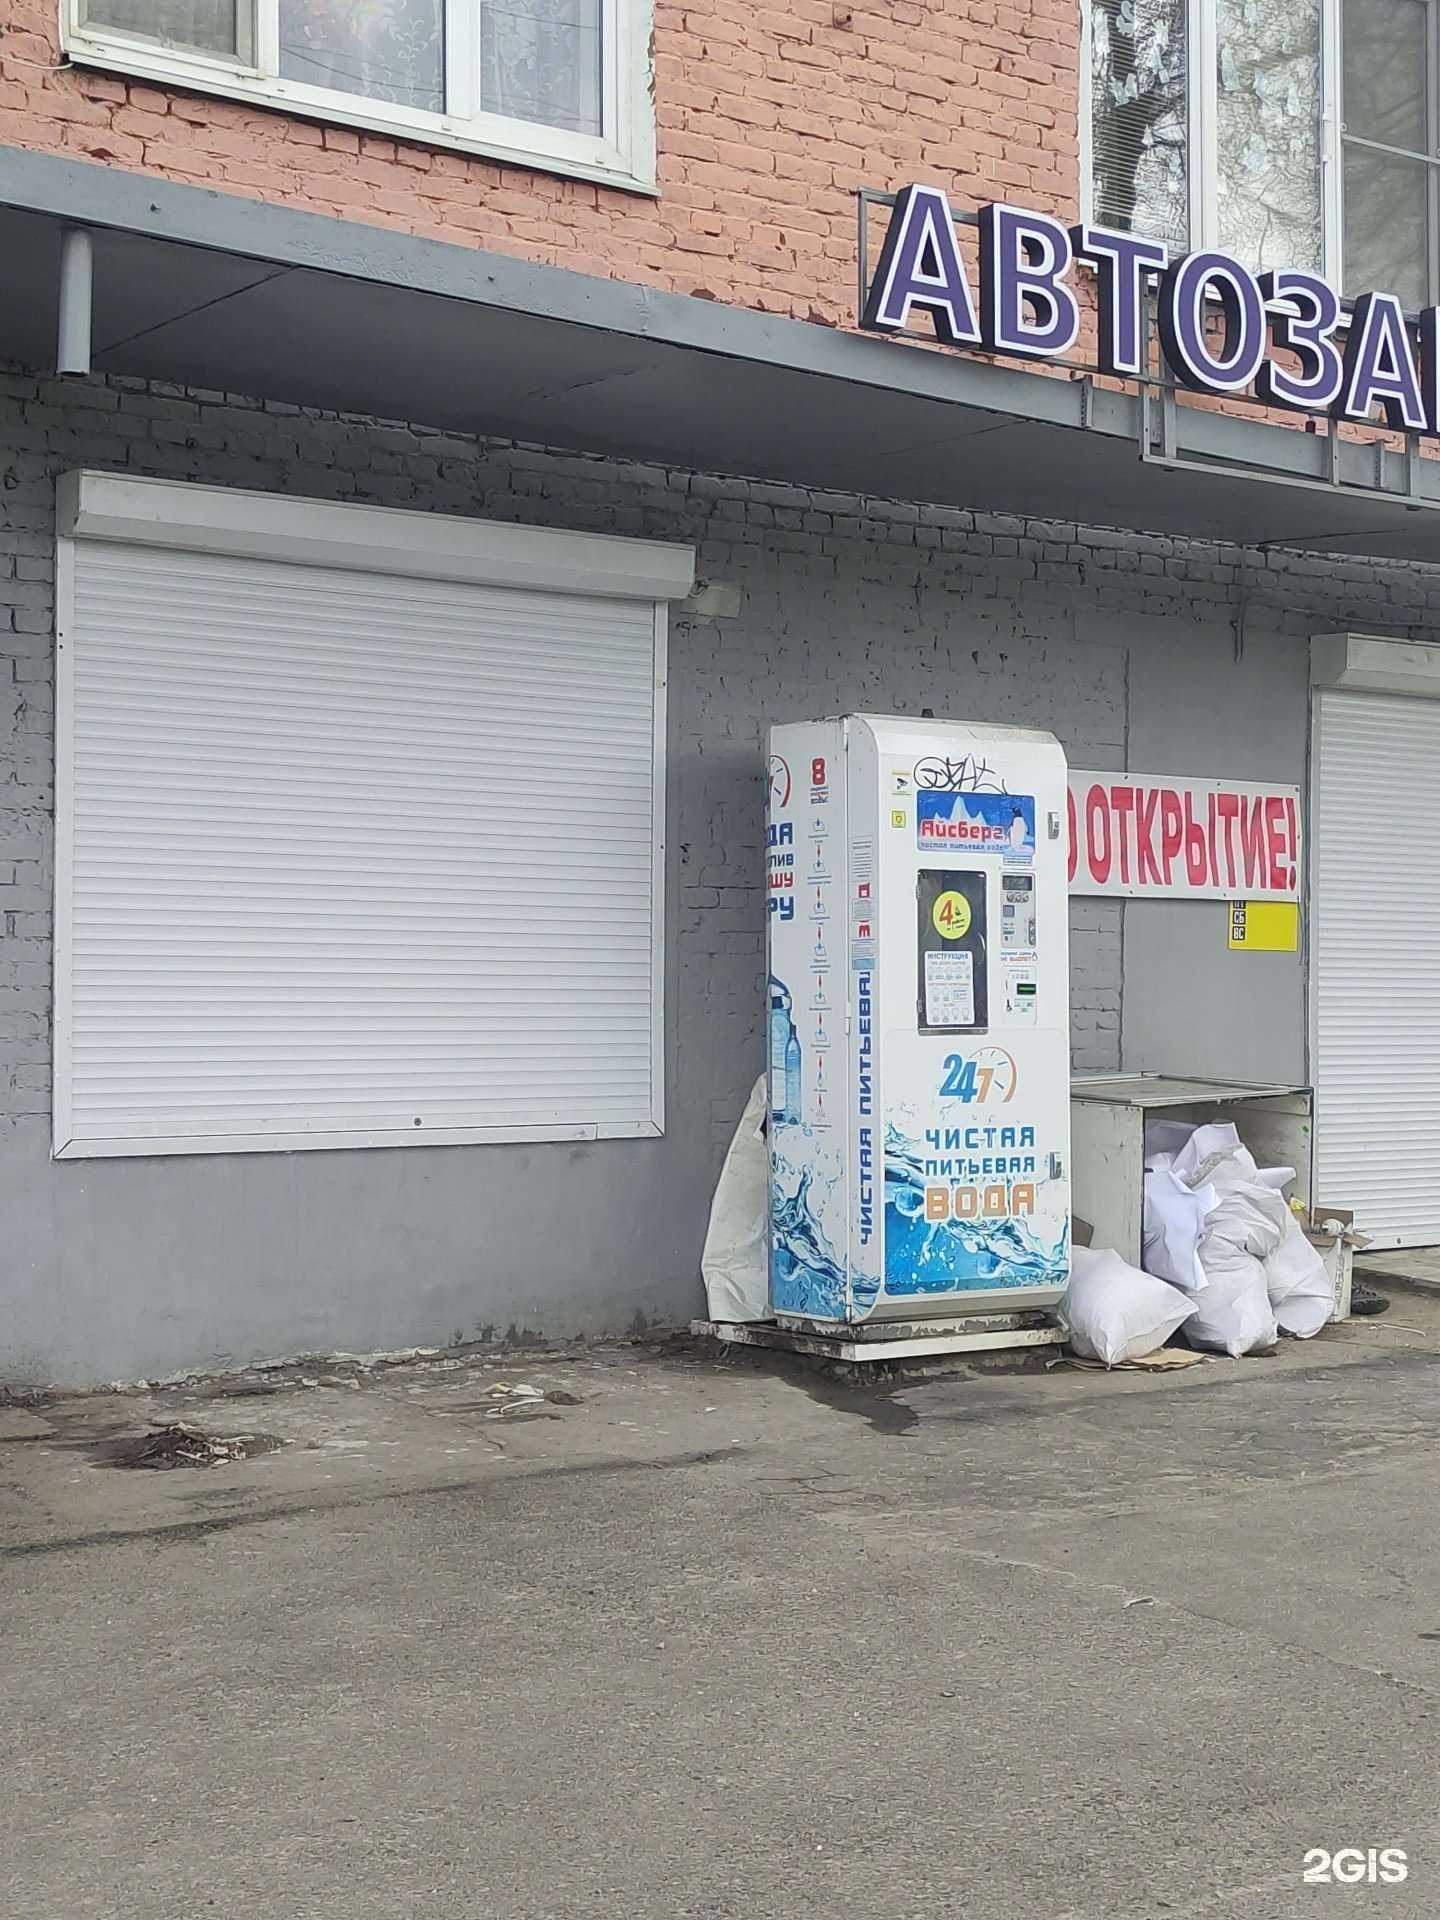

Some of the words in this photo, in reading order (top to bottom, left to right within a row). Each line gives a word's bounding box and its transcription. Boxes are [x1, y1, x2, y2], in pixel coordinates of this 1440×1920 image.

[866, 183, 1440, 435] АВТОЗА
[811, 757, 826, 786] 8
[921, 820, 1004, 842] Айсберг
[1085, 783, 1297, 890] ОТКРЫТИЕ!
[1233, 911, 1245, 924] СБ
[1233, 927, 1245, 940] ВС
[925, 1126, 1035, 1150] ЧИСТАЯ
[925, 1157, 1035, 1177] ПИТЬЕВАЯ
[860, 1127, 873, 1245] ЧИСТАЯ
[925, 1183, 1035, 1221] ВОДА
